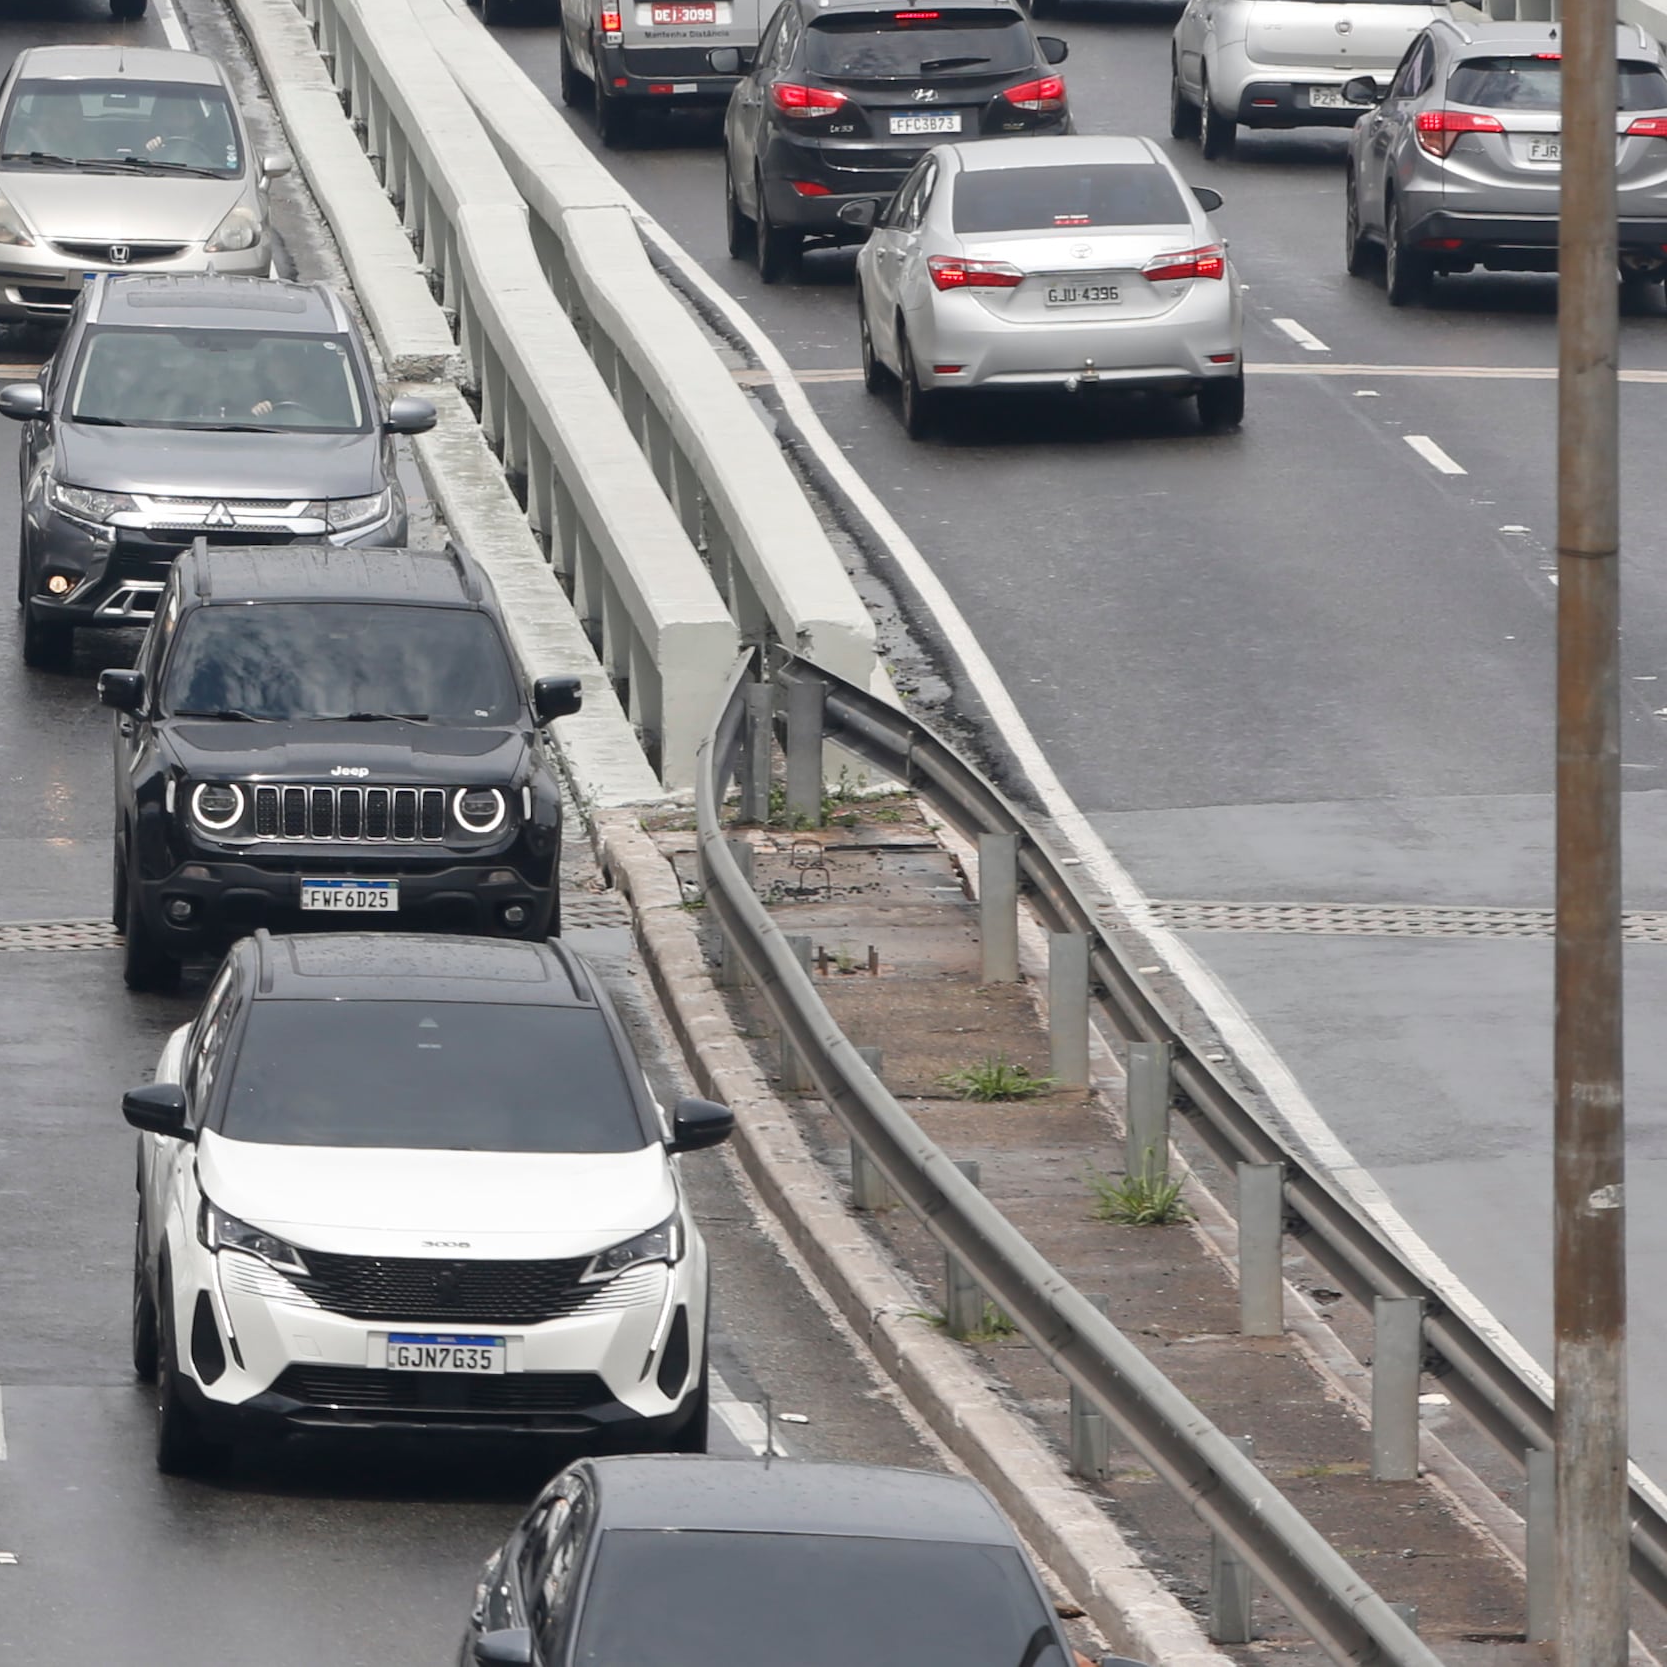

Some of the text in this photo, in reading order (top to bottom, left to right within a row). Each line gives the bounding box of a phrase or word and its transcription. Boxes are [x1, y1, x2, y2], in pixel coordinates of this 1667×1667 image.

[645, 30, 687, 38] Mantenha
[330, 766, 370, 778] Jeep
[309, 887, 389, 909] FWF6D25
[421, 1240, 471, 1249] 3008
[398, 1346, 492, 1370] GJN7G35
